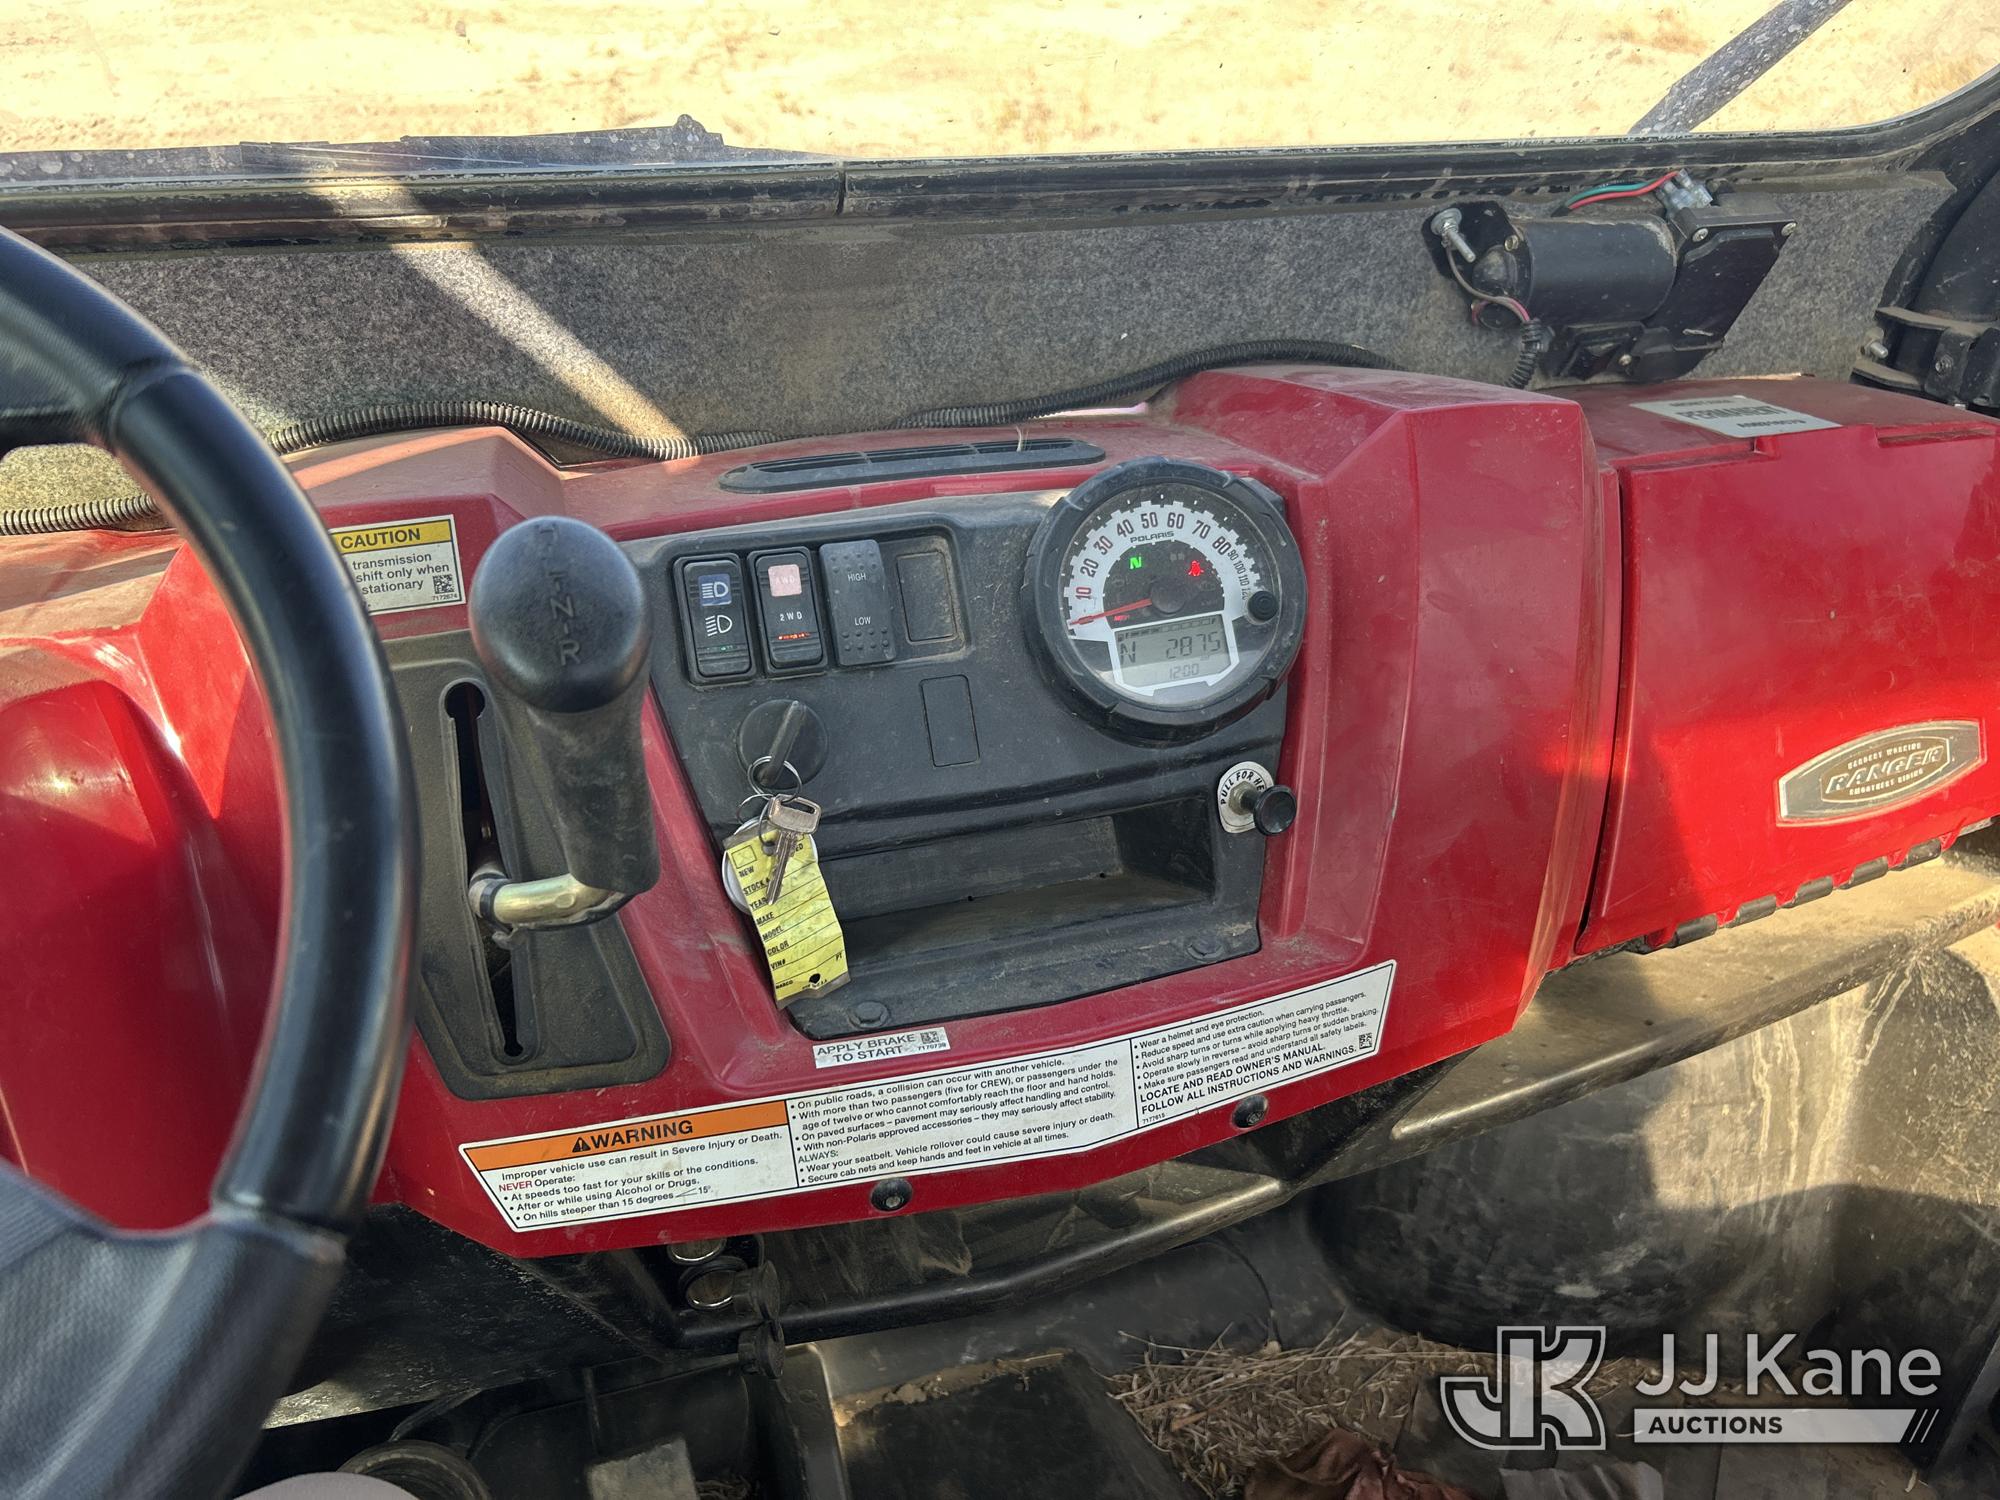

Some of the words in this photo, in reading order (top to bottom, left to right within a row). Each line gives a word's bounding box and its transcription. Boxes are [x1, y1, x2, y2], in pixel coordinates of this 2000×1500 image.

[1116, 519, 1135, 537] 40
[1141, 512, 1158, 529] 50
[1167, 512, 1184, 529] 60
[1191, 520, 1211, 539] 70
[340, 528, 421, 550] CAUTION
[1093, 535, 1113, 555] 30
[1130, 531, 1174, 544] POLARIS
[1212, 536, 1231, 555] 80
[352, 553, 432, 570] transmission
[1129, 556, 1142, 569] N
[1227, 550, 1239, 561] 90
[355, 571, 384, 583] shift
[386, 567, 414, 581] only
[416, 563, 450, 575] when
[1080, 559, 1099, 577] 20
[1233, 560, 1246, 574] 100
[361, 579, 424, 595] stationary
[847, 573, 867, 582] HIGH
[1238, 574, 1250, 586] 110
[1076, 586, 1091, 600] 10
[550, 595, 574, 619] N
[855, 617, 871, 625] LOW
[560, 639, 581, 666] R
[1120, 641, 1136, 665] N
[1166, 631, 1221, 660] 2875
[1825, 746, 1944, 794] RANGER
[1220, 779, 1234, 805] PULL
[1236, 771, 1254, 781] FOR
[1254, 777, 1265, 791] HE
[739, 865, 754, 877] NEW
[756, 911, 774, 925] MAKE
[762, 927, 783, 941] MODEL
[767, 941, 789, 956] COLOR
[1139, 1038, 1160, 1049] Wear
[1167, 1028, 1194, 1041] helmet
[1194, 1023, 1209, 1034] and
[1210, 1021, 1224, 1030] eye
[1225, 1010, 1264, 1026] protection.
[1140, 1046, 1170, 1059] Reduce
[1171, 1038, 1195, 1051] speed
[1196, 1034, 1211, 1043] and
[1212, 1031, 1226, 1039] use
[1227, 1025, 1246, 1035] extra
[1246, 1017, 1274, 1029] caution
[1274, 1011, 1295, 1021] when
[1295, 1003, 1324, 1016] carrying
[1325, 992, 1366, 1009] passengers.
[818, 1040, 862, 1057] APPLY
[867, 1034, 915, 1050] BRAKE
[833, 1051, 854, 1064] TO
[858, 1046, 903, 1060] START
[1139, 1083, 1180, 1102] LOCATE
[1182, 1076, 1206, 1090] AND
[1205, 1068, 1233, 1083] READ
[1235, 1055, 1281, 1074] OWNER'S
[1282, 1043, 1326, 1061] MANUAL.
[1141, 1095, 1184, 1114] FOLLOW
[1186, 1090, 1205, 1101] ALL
[1207, 1067, 1279, 1095] INSTRUCTIONS
[1281, 1060, 1302, 1073] AND
[1303, 1044, 1357, 1066] WARNINGS.
[797, 1100, 812, 1109] On
[813, 1095, 844, 1108] public
[845, 1090, 875, 1102] roads,
[886, 1082, 924, 1094] collision
[926, 1079, 943, 1088] can
[945, 1075, 971, 1084] occur
[973, 1070, 993, 1079] with
[994, 1064, 1029, 1076] another
[1030, 1059, 1065, 1069] vehicle.
[798, 1109, 820, 1119] With
[822, 1106, 846, 1115] more
[848, 1102, 869, 1111] than
[871, 1098, 889, 1107] two
[890, 1089, 942, 1105] passengers
[944, 1086, 963, 1096] (five
[965, 1083, 978, 1091] for
[980, 1076, 1014, 1089] CREW),
[1014, 1075, 1025, 1083] or
[1026, 1068, 1076, 1083] passengers
[1077, 1062, 1102, 1072] under
[1104, 1059, 1118, 1067] the
[590, 1119, 694, 1149] WARNING
[805, 1162, 830, 1172] Wear
[831, 1158, 853, 1170] your
[854, 1150, 893, 1163] seatbelt.
[894, 1144, 928, 1155] Vehicle
[930, 1138, 964, 1150] rollover
[965, 1132, 991, 1144] could
[993, 1130, 1020, 1139] cause
[1021, 1124, 1050, 1135] severe
[1052, 1119, 1078, 1130] injury
[1089, 1111, 1115, 1123] death.
[501, 1168, 547, 1180] Improper
[549, 1162, 585, 1173] vehicle
[608, 1156, 627, 1164] can
[629, 1150, 657, 1161] result
[659, 1149, 669, 1157] in
[671, 1144, 705, 1155] Severe
[708, 1139, 736, 1150] Injury
[737, 1137, 749, 1145] or
[750, 1132, 782, 1143] Death.
[797, 1150, 838, 1163] ALWAYS:
[498, 1180, 533, 1192] NEVER
[534, 1175, 575, 1188] Operate:
[510, 1193, 522, 1201] At
[524, 1187, 561, 1200] speeds
[563, 1185, 580, 1193] too
[582, 1181, 602, 1190] fast
[604, 1179, 618, 1187] for
[620, 1175, 643, 1186] your
[645, 1171, 671, 1181] skills
[686, 1166, 702, 1174] the
[704, 1158, 758, 1171] conditions.
[517, 1202, 541, 1211] After
[556, 1195, 583, 1205] while
[585, 1191, 612, 1201] using
[614, 1183, 652, 1196] Alcohol
[667, 1178, 699, 1190] Drugs.
[522, 1213, 537, 1221] On
[538, 1209, 558, 1219] hills
[560, 1204, 596, 1215] steeper
[598, 1201, 619, 1209] than
[621, 1197, 634, 1206] 15
[635, 1193, 676, 1204] degrees
